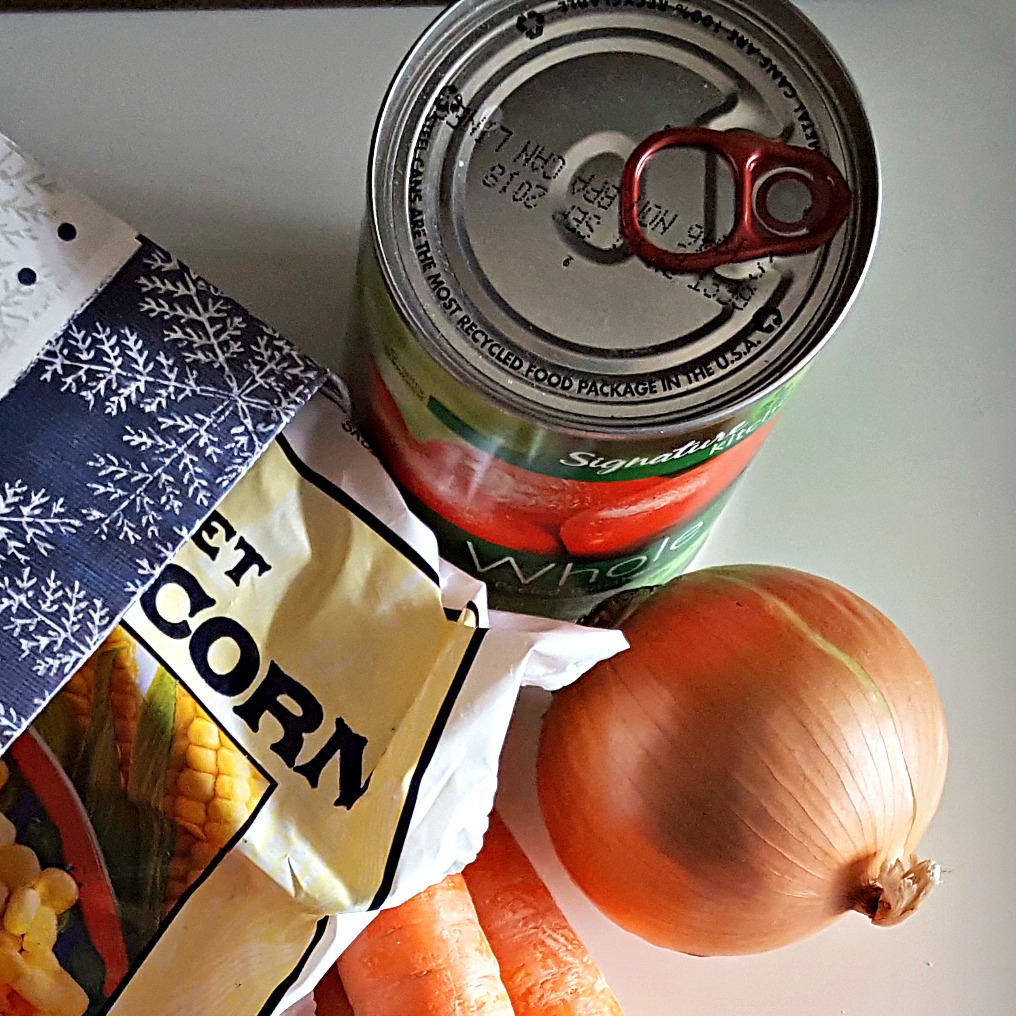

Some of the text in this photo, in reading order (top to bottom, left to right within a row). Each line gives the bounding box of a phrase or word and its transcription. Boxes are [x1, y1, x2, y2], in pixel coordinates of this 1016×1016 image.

[675, 4, 722, 33] 100%
[726, 30, 761, 56] ARE
[759, 57, 797, 98] CANS
[514, 140, 566, 180] CAN
[408, 157, 425, 203] CANS
[482, 163, 548, 209] 2018
[409, 207, 427, 238] ARE
[416, 240, 437, 272] THE
[428, 273, 462, 317] MOST
[457, 314, 524, 371] RECYCLED
[715, 338, 763, 370] U.S.A.
[524, 362, 574, 391] FOOD
[576, 381, 658, 398] PACKAGE
[661, 374, 683, 393] IN
[685, 362, 714, 385] THE
[559, 420, 747, 475] Signature
[466, 521, 704, 586] Whole
[139, 563, 374, 811] CORN
